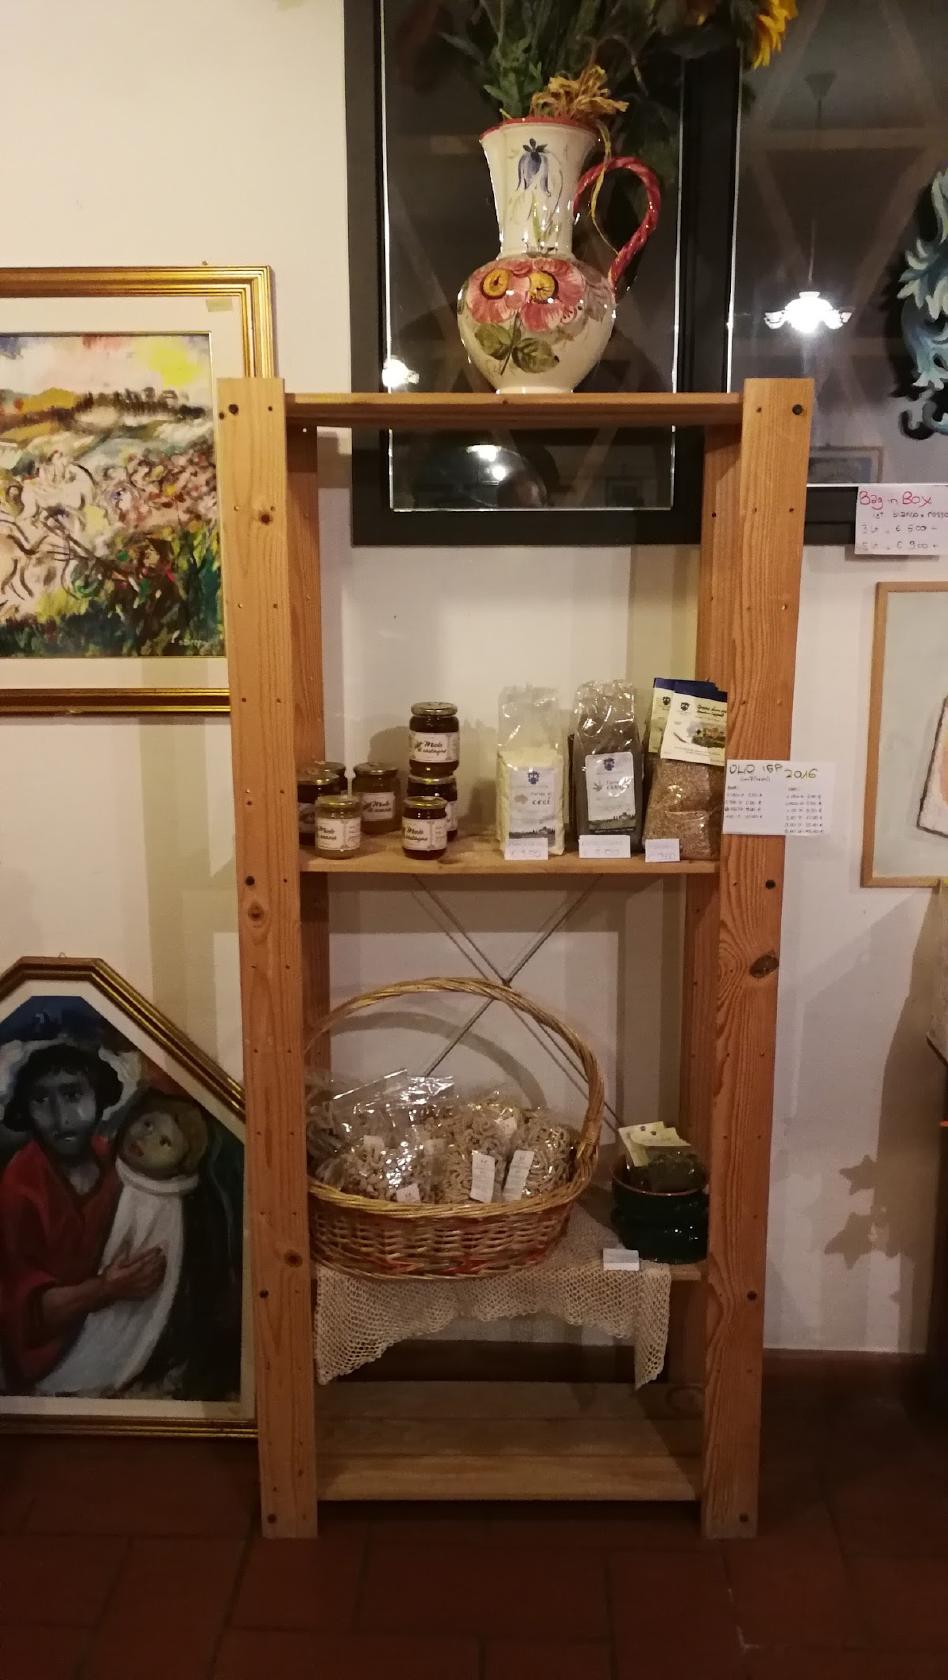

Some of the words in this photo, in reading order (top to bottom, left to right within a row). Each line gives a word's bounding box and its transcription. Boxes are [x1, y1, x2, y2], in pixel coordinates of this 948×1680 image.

[859, 490, 884, 510] Bag
[902, 491, 932, 507] Box
[729, 763, 756, 775] OLIO
[784, 768, 818, 780] 2016
